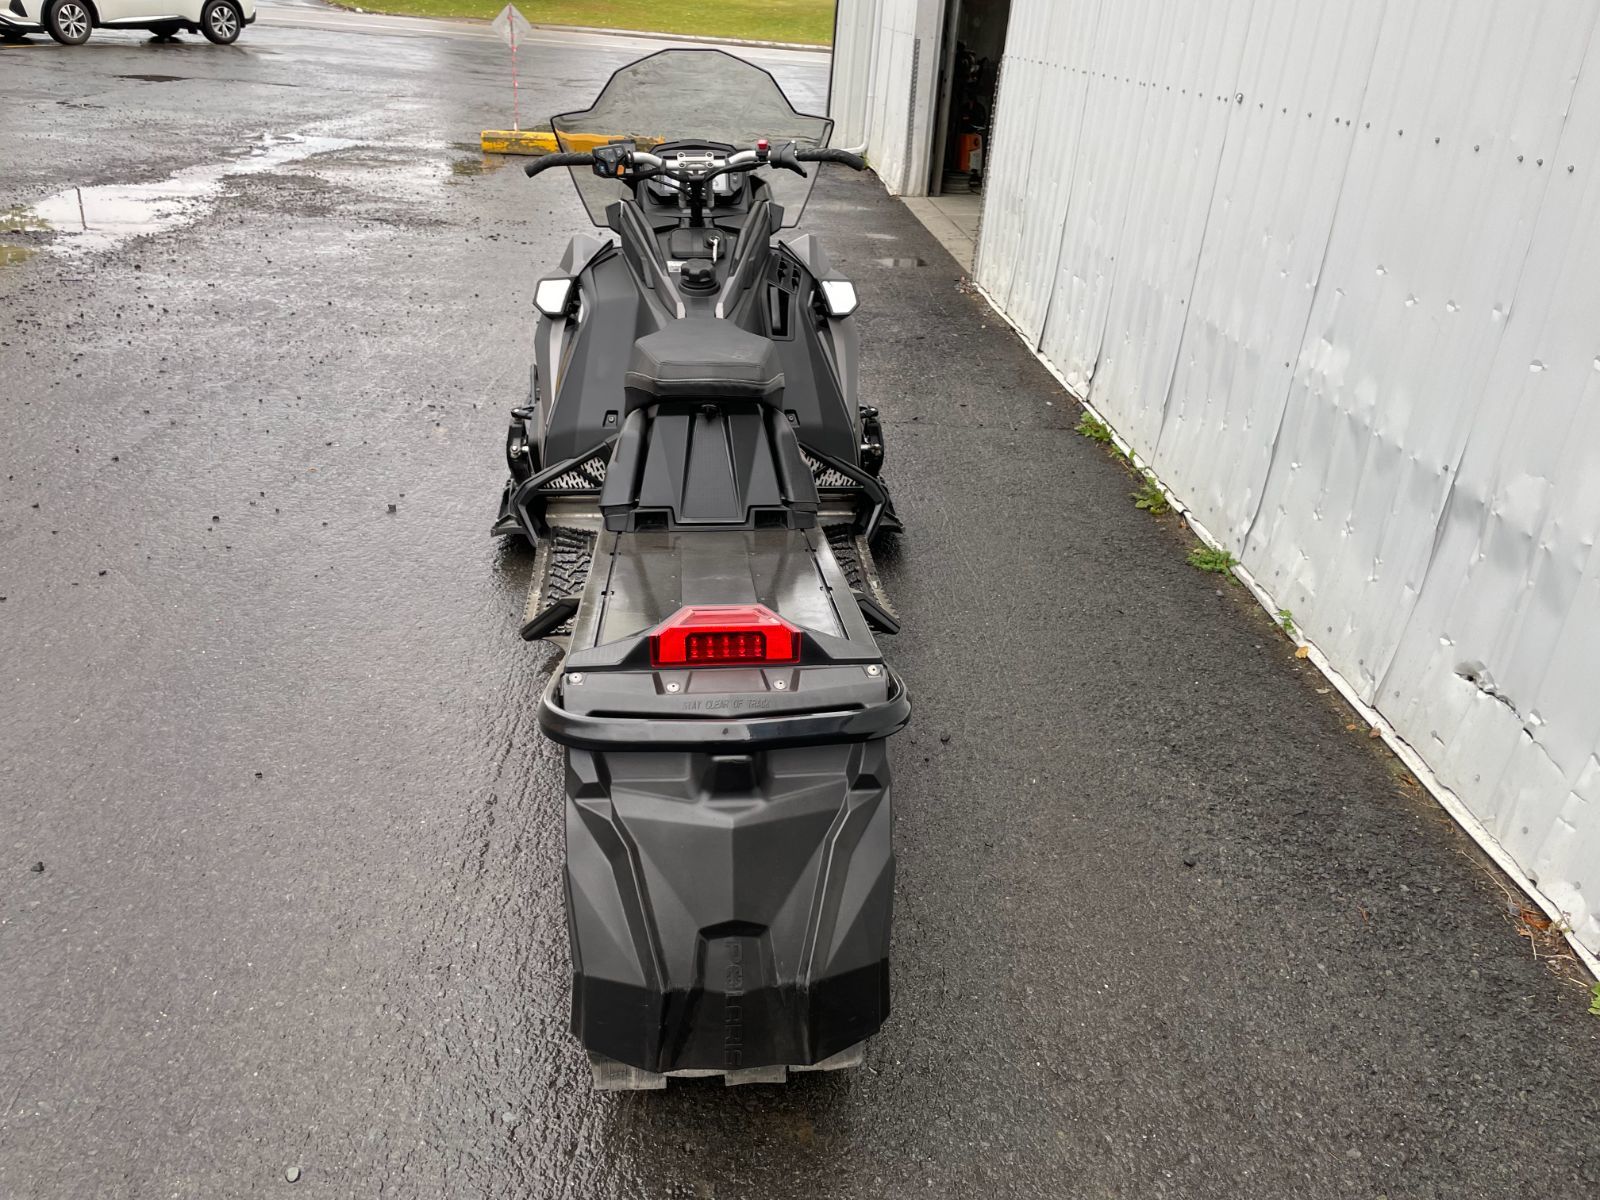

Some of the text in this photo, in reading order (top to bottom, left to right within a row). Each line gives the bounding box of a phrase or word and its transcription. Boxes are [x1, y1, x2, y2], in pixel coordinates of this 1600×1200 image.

[682, 700, 701, 711] STAY
[704, 699, 730, 710] CLEAR
[733, 699, 743, 709] OF
[723, 940, 744, 1066] POLARIS
